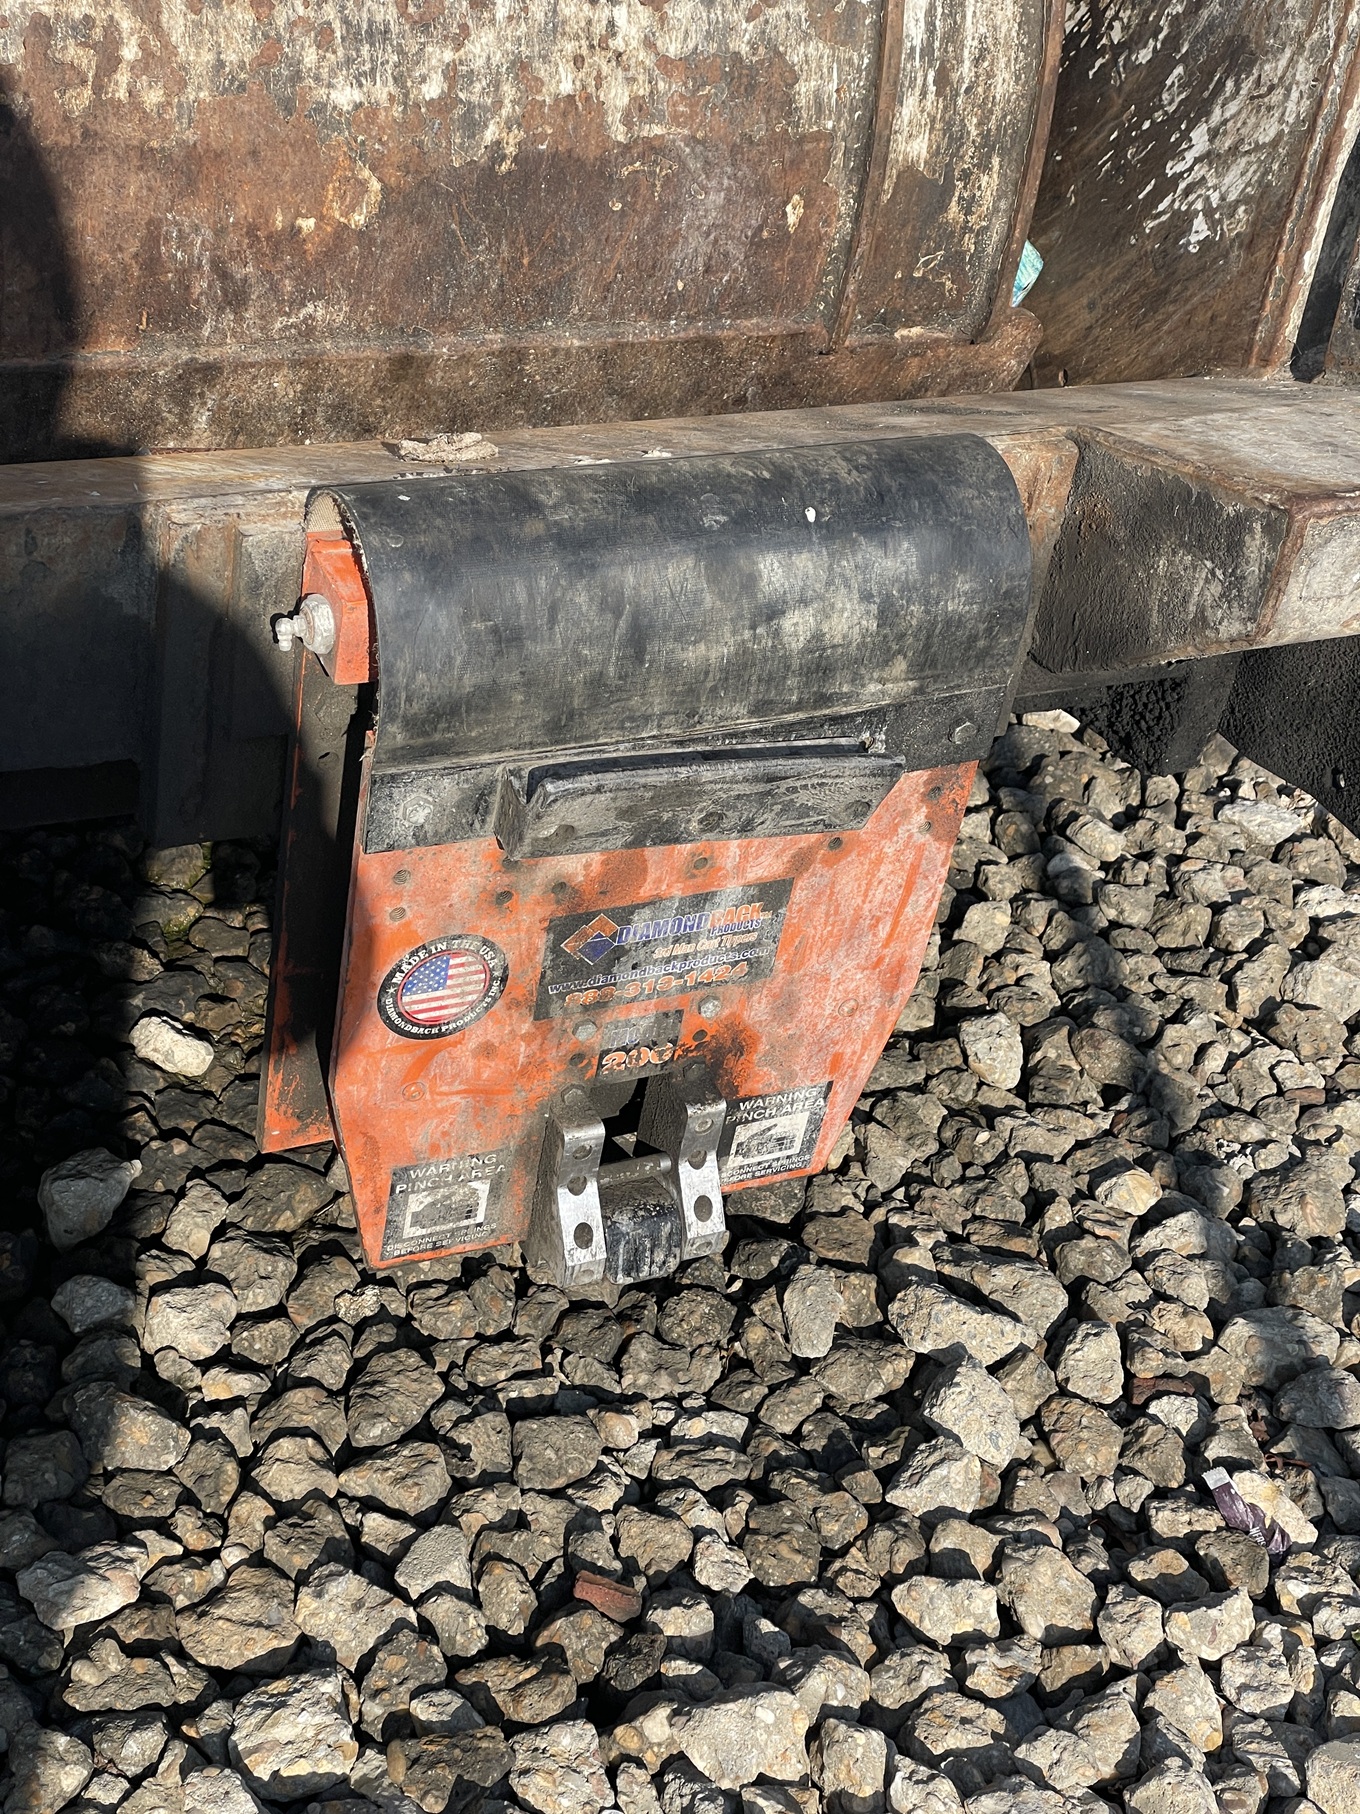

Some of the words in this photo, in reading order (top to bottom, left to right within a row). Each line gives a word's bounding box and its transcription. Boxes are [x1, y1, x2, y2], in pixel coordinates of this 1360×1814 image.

[710, 918, 762, 936] PRODUCTS
[671, 941, 696, 956] Man
[391, 949, 429, 985] MADE
[430, 941, 447, 955] IN
[451, 939, 481, 951] THE
[479, 945, 499, 968] USA
[739, 1088, 818, 1111] WARNING
[781, 1097, 825, 1117] AREA
[409, 1154, 497, 1179] WARNING
[386, 1233, 451, 1252] DISCONNECT
